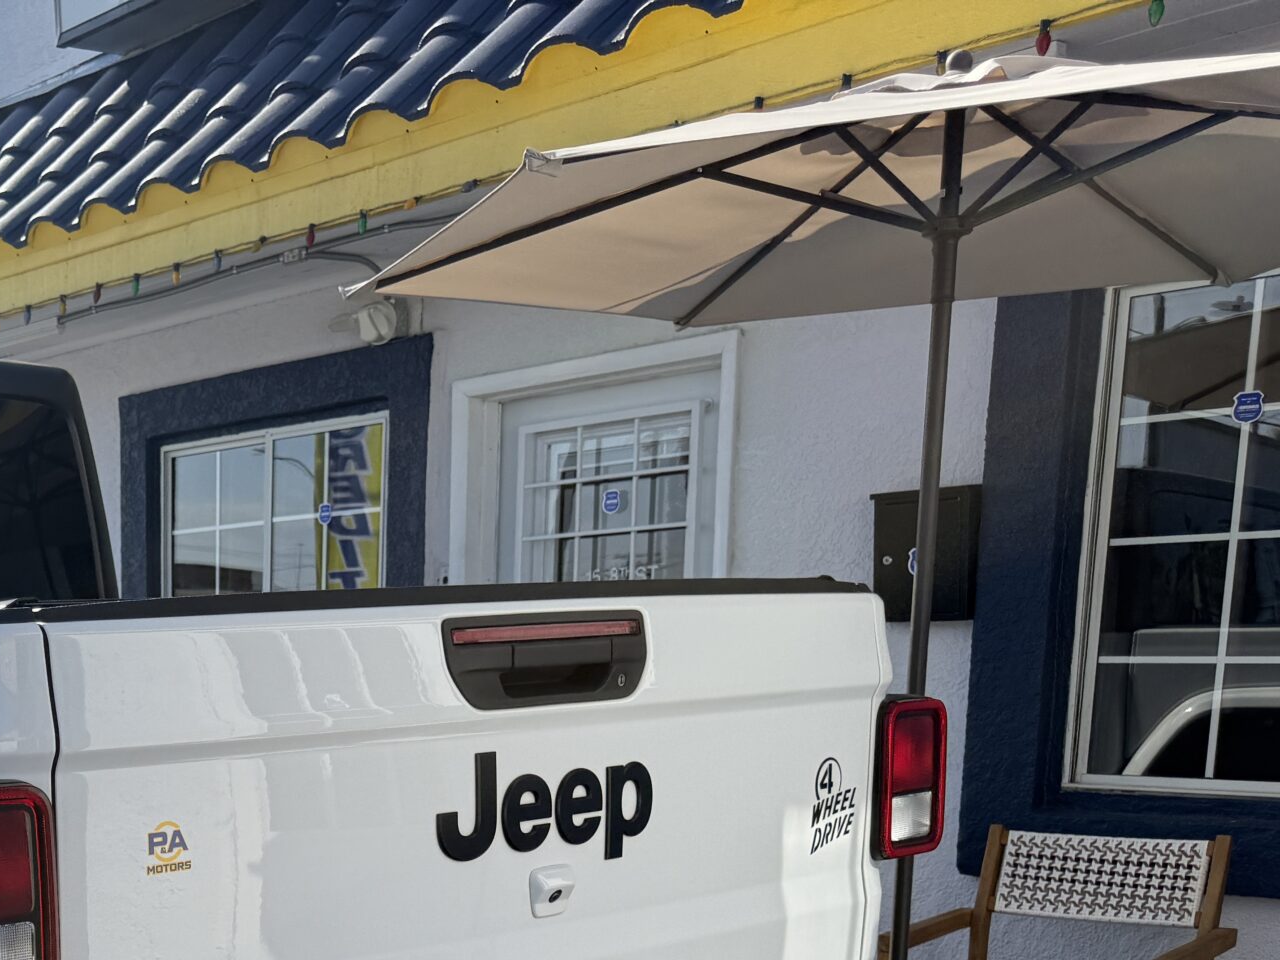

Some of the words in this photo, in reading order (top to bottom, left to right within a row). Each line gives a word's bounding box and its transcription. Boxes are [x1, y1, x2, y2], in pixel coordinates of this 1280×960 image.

[820, 763, 833, 794] 4
[436, 751, 653, 862] Jeep
[811, 787, 856, 828] WHEEL
[810, 812, 854, 855] DRIVE
[146, 860, 192, 876] MOTORS
